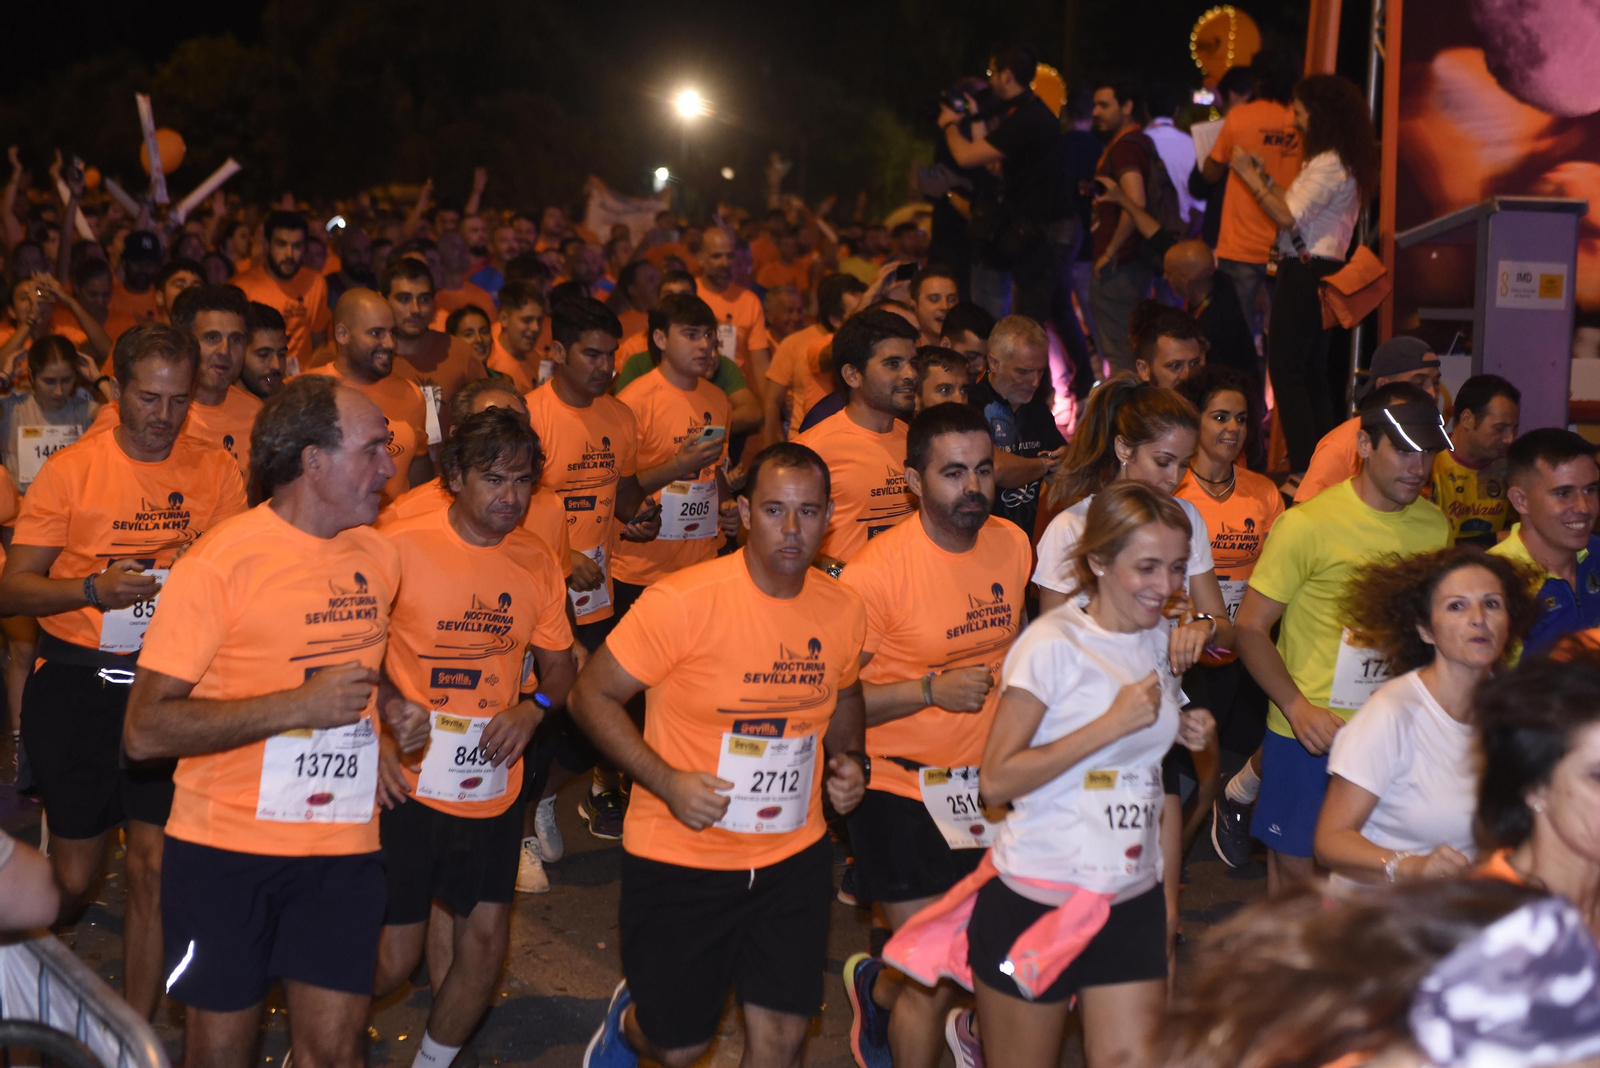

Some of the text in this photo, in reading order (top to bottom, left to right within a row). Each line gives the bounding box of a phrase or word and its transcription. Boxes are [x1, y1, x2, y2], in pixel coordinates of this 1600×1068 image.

[567, 461, 597, 471] SEVILLA
[870, 486, 902, 497] SEVILLA
[680, 501, 709, 516] 2605
[135, 511, 190, 522] NOCTURNA
[112, 520, 160, 531] SEVILLA
[1216, 533, 1259, 542] NOCTURNA
[328, 596, 377, 608] NOCTURNA
[305, 609, 353, 625] SEVILLA
[464, 611, 513, 625] NOCTURNA
[966, 604, 1011, 620] NOCTURNA
[437, 620, 481, 632] SEVILLA
[946, 620, 988, 639] SEVILLA
[773, 662, 825, 672] NOCTURNA
[743, 673, 796, 684] SEVILLA
[295, 753, 358, 778] 13728
[750, 770, 799, 793] 2712
